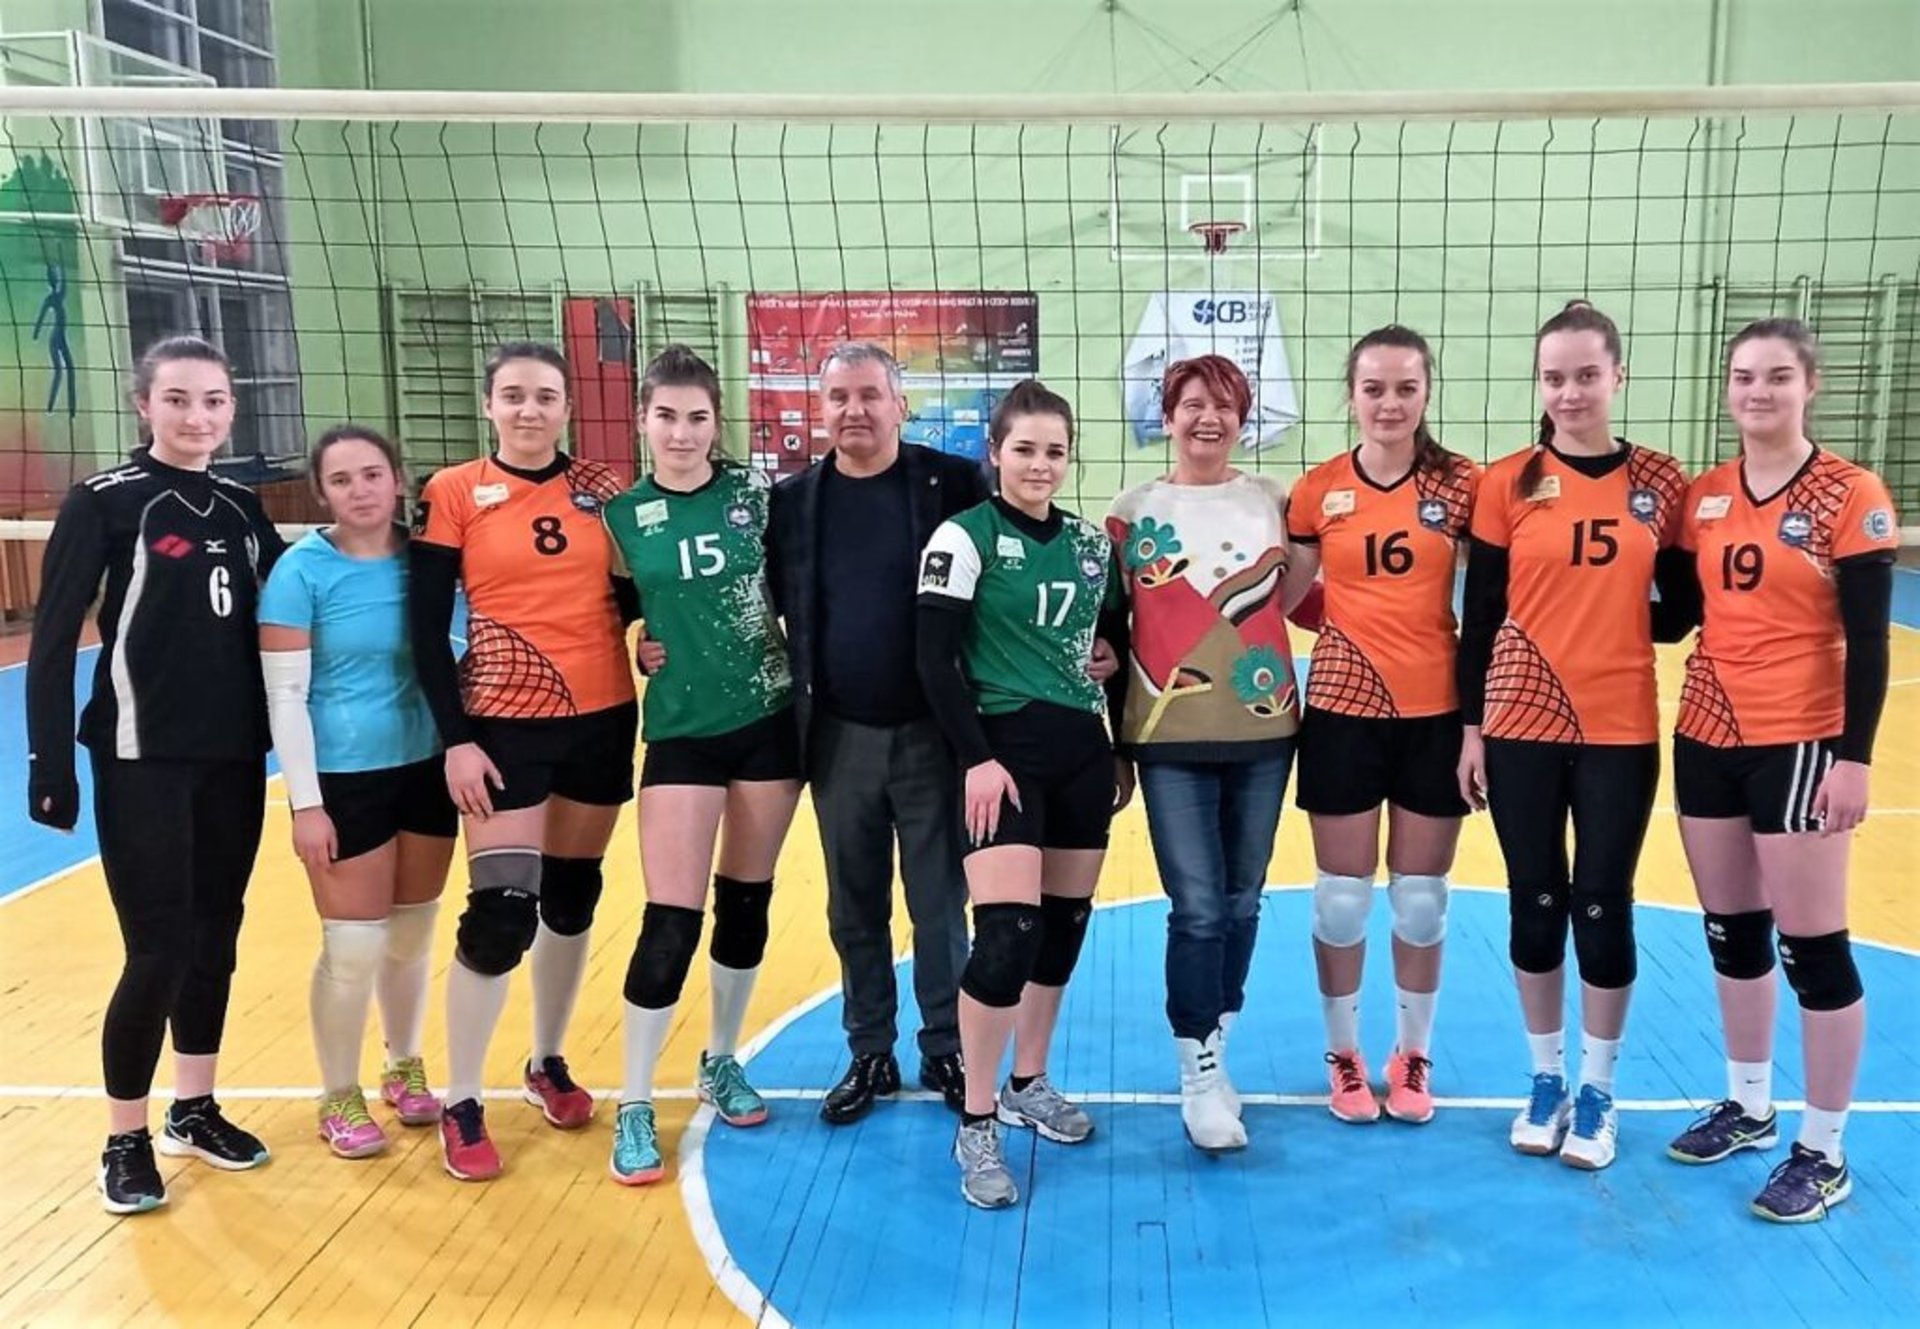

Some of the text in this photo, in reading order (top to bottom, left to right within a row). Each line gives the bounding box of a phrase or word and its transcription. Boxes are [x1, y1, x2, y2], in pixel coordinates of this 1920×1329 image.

[532, 516, 568, 555] 8
[677, 533, 726, 580] 15
[1365, 530, 1414, 576] 16
[1570, 519, 1619, 567] 15
[1722, 543, 1764, 591] 19
[209, 566, 232, 617] 6
[1037, 582, 1077, 627] 17
